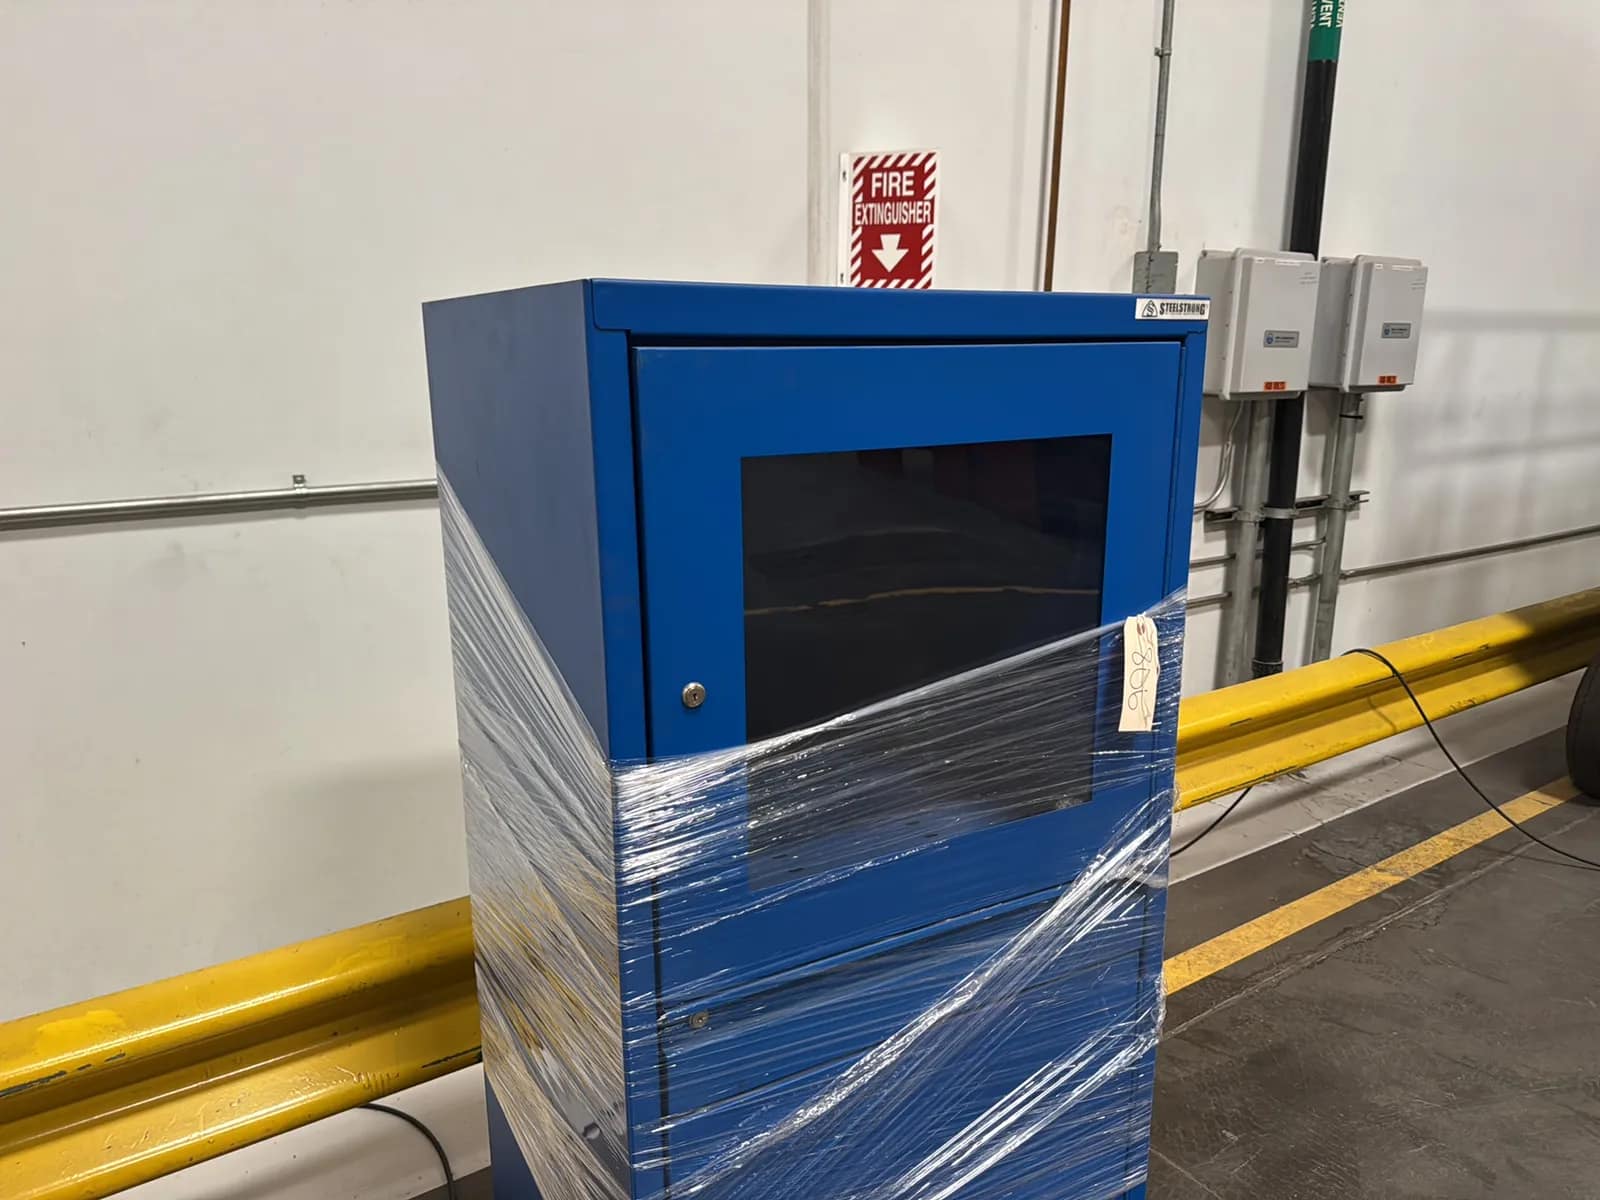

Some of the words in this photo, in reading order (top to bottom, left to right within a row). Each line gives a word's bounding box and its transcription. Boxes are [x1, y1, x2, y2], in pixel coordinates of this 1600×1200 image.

[871, 171, 915, 198] FIRE
[855, 201, 931, 225] EXTINGUISHER
[1160, 302, 1206, 315] STEELSTRONG
